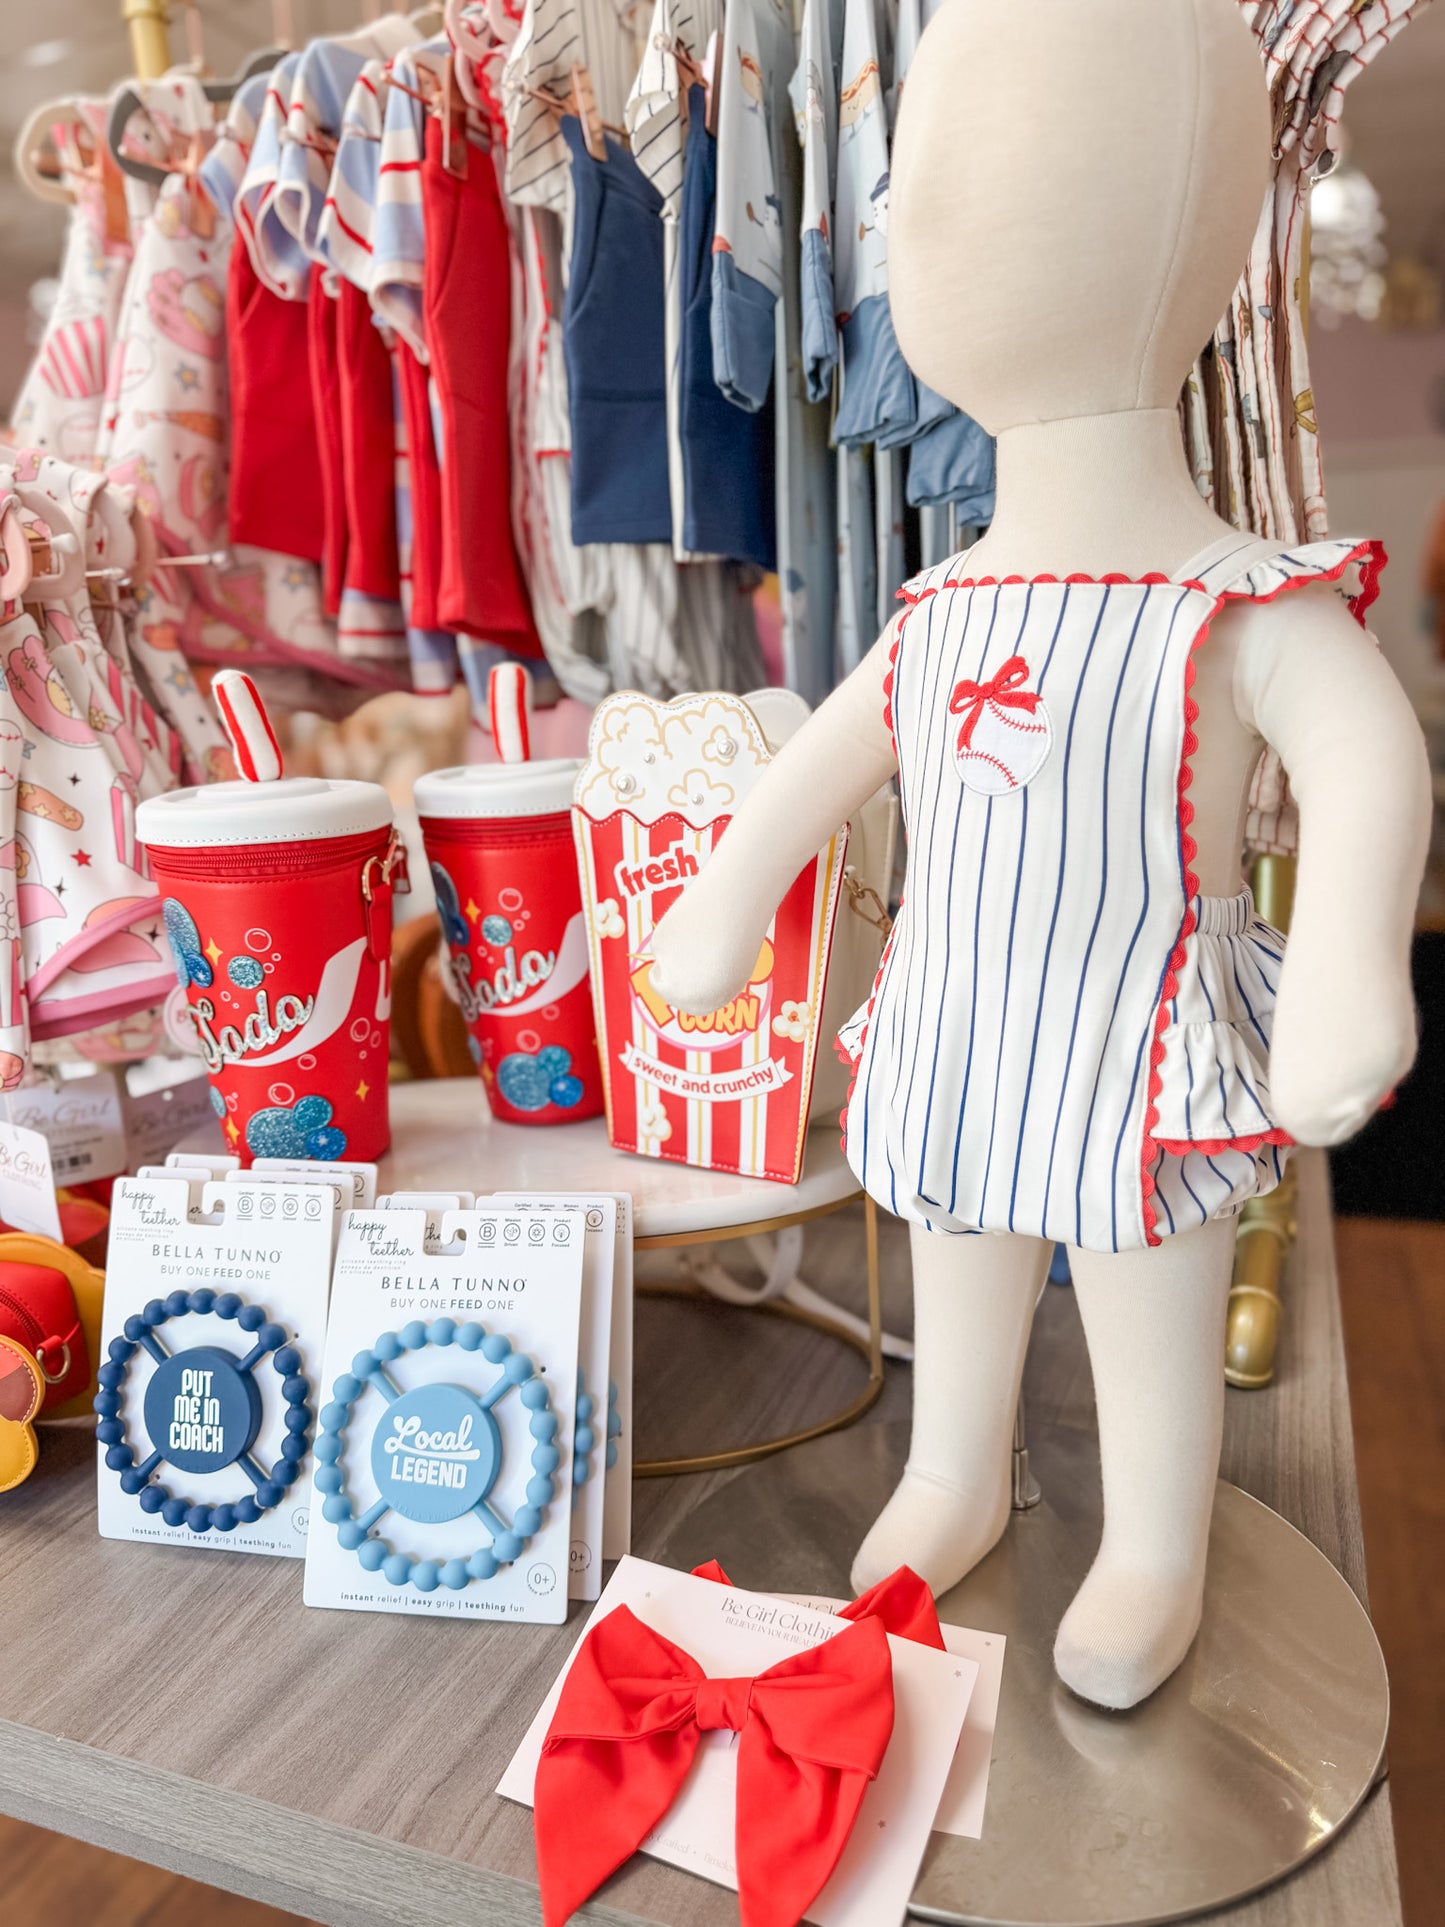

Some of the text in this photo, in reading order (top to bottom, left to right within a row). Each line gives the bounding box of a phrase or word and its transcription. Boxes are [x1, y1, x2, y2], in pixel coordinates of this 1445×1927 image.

[620, 847, 699, 896] fresh
[448, 946, 555, 1023] Soda
[187, 986, 314, 1075] Soda
[634, 1057, 773, 1094] sweet and crunchy
[14, 1151, 48, 1178] Girl
[121, 1182, 155, 1210] happy
[139, 1207, 181, 1226] teether
[348, 1211, 387, 1241] happy
[152, 1244, 281, 1263] BELLA TUNNO
[368, 1238, 415, 1256] teether
[160, 1264, 271, 1280] BUY ONE FEED ONE
[381, 1276, 526, 1292] BELLA TUNNO
[390, 1297, 514, 1310] BUY ONE FEED ONE
[181, 1368, 213, 1397] PUT
[174, 1395, 220, 1425] ME IN
[169, 1422, 224, 1453] COACH
[384, 1414, 480, 1460] Local
[391, 1455, 467, 1489] LEGEND
[132, 1527, 160, 1536] instant
[164, 1530, 185, 1538] relief
[214, 1535, 231, 1544] grip
[239, 1538, 275, 1549] teething
[278, 1541, 292, 1549] fun
[570, 1550, 585, 1562] 0+
[534, 1572, 550, 1584] 0+
[340, 1592, 525, 1613] instant relief easy grip teething fun
[721, 1597, 743, 1615] Be
[746, 1603, 778, 1624] Girl
[779, 1614, 838, 1641] Clothi
